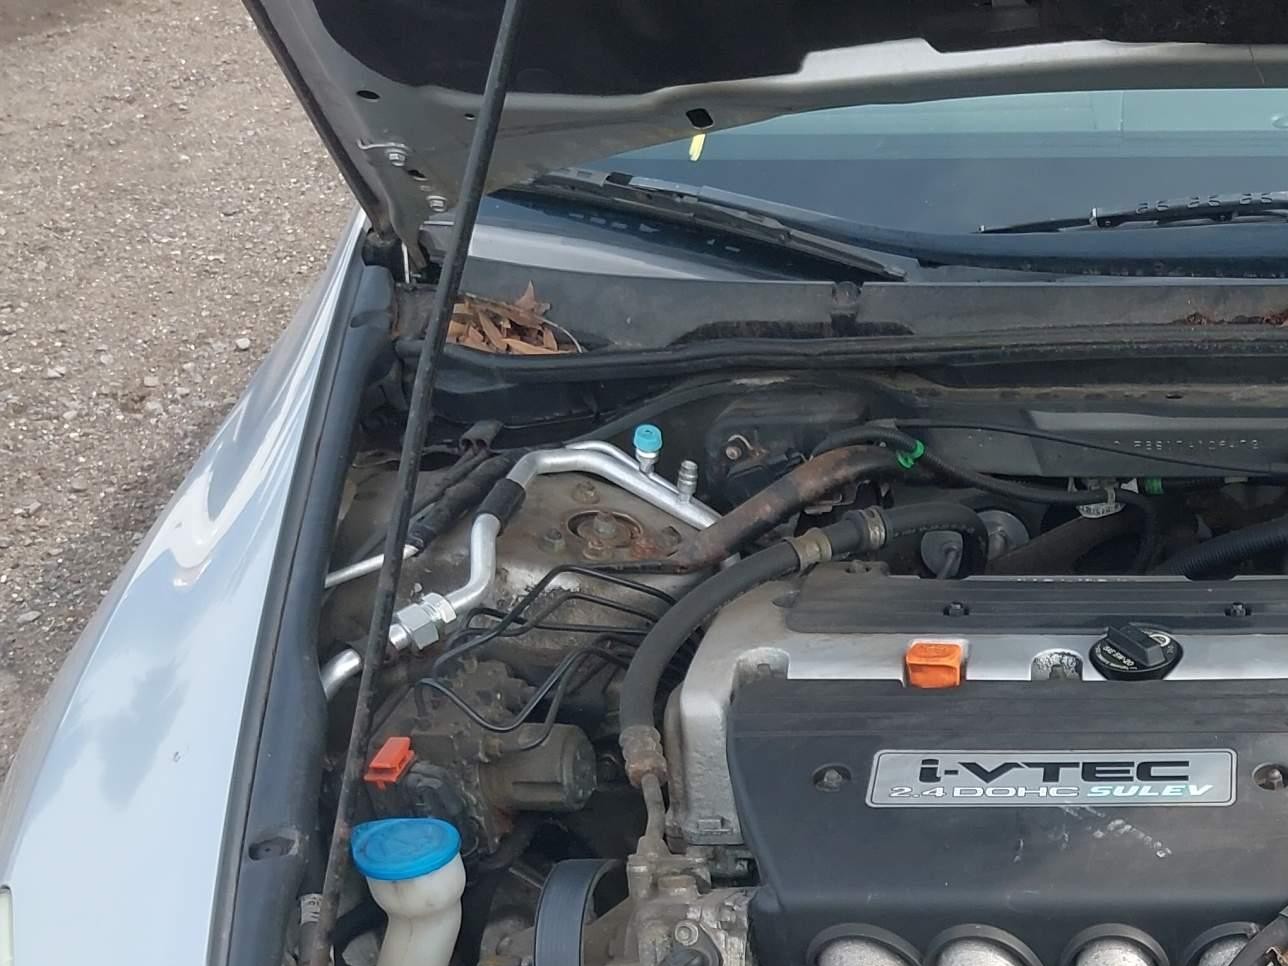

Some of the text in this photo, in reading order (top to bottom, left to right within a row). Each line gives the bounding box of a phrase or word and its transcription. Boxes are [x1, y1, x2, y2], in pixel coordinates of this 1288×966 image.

[919, 758, 1190, 784] i-VTEC
[889, 783, 1215, 798] 2.4 DOHC SULEV
